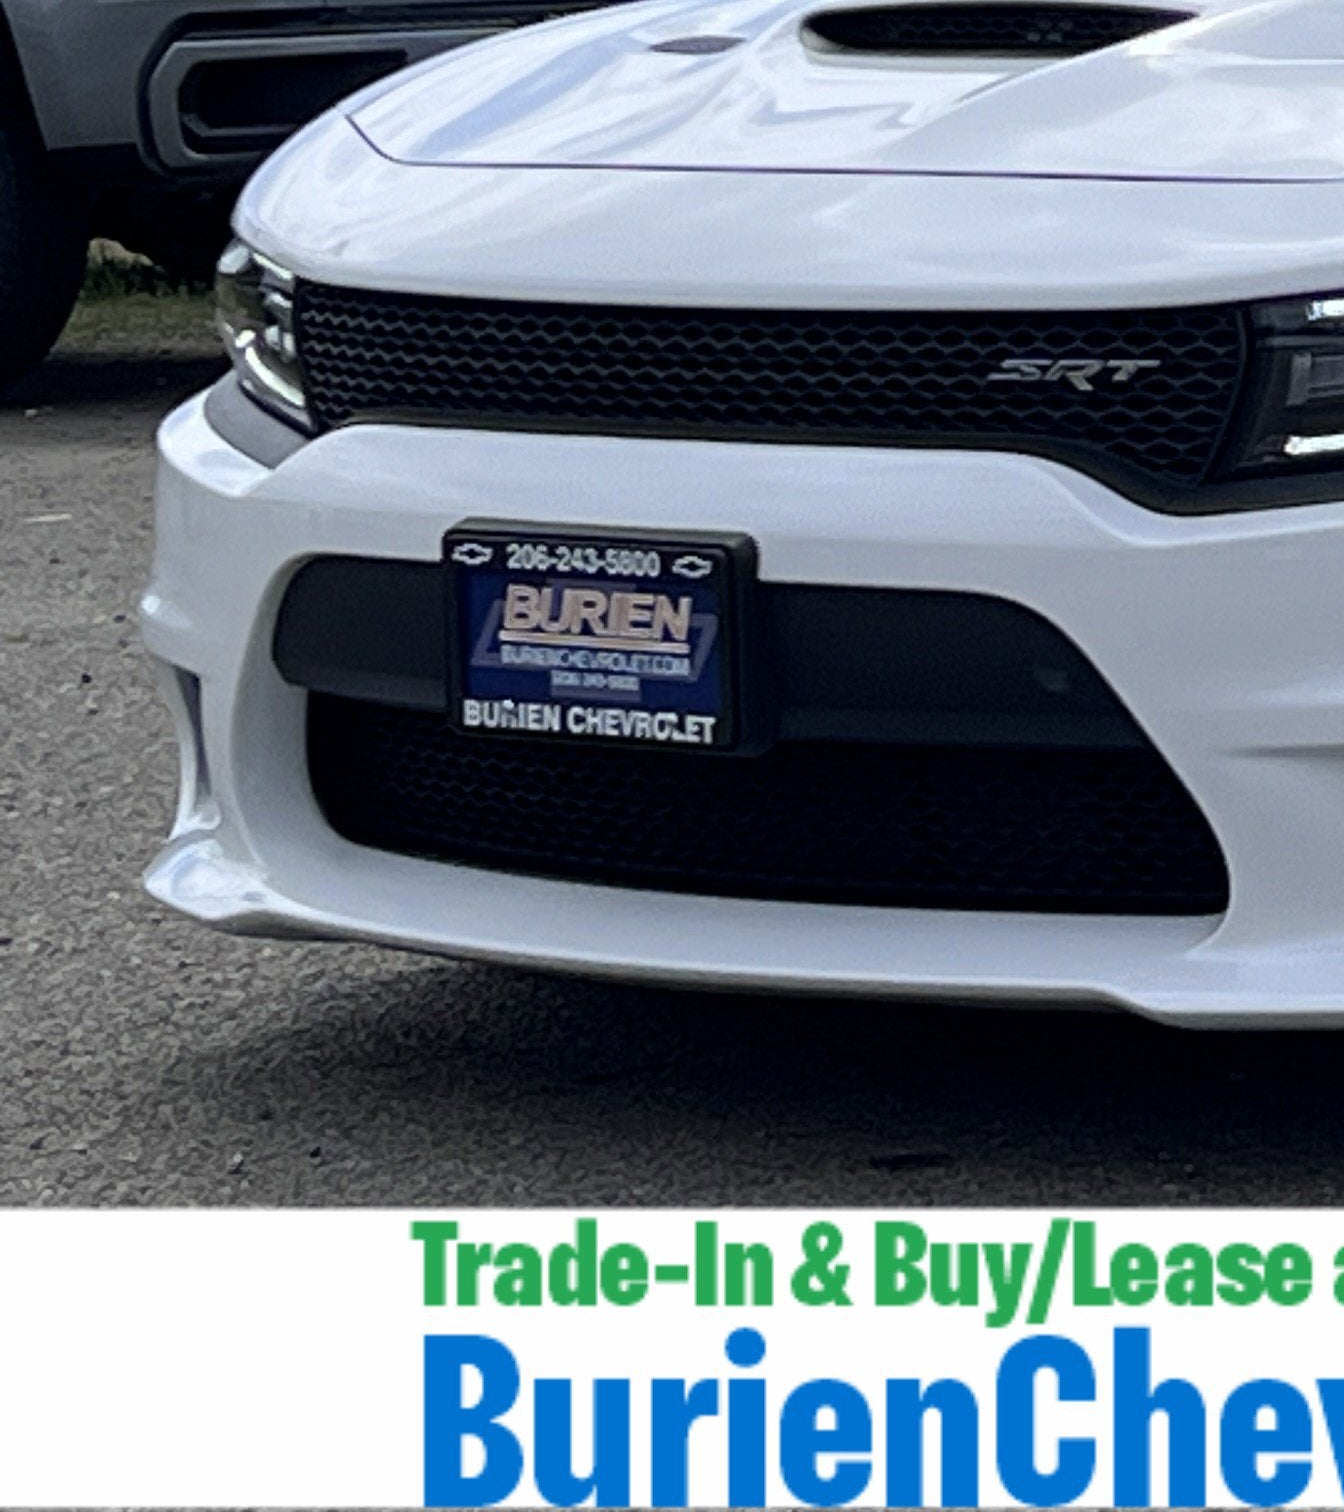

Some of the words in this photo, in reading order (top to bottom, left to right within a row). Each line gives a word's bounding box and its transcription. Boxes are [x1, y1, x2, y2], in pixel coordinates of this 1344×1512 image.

[986, 358, 1161, 391] SRT
[506, 543, 661, 578] 206-243-5800
[503, 583, 693, 641] BURIEN
[463, 699, 561, 731] BURIEN
[567, 706, 716, 744] CHEVROLET
